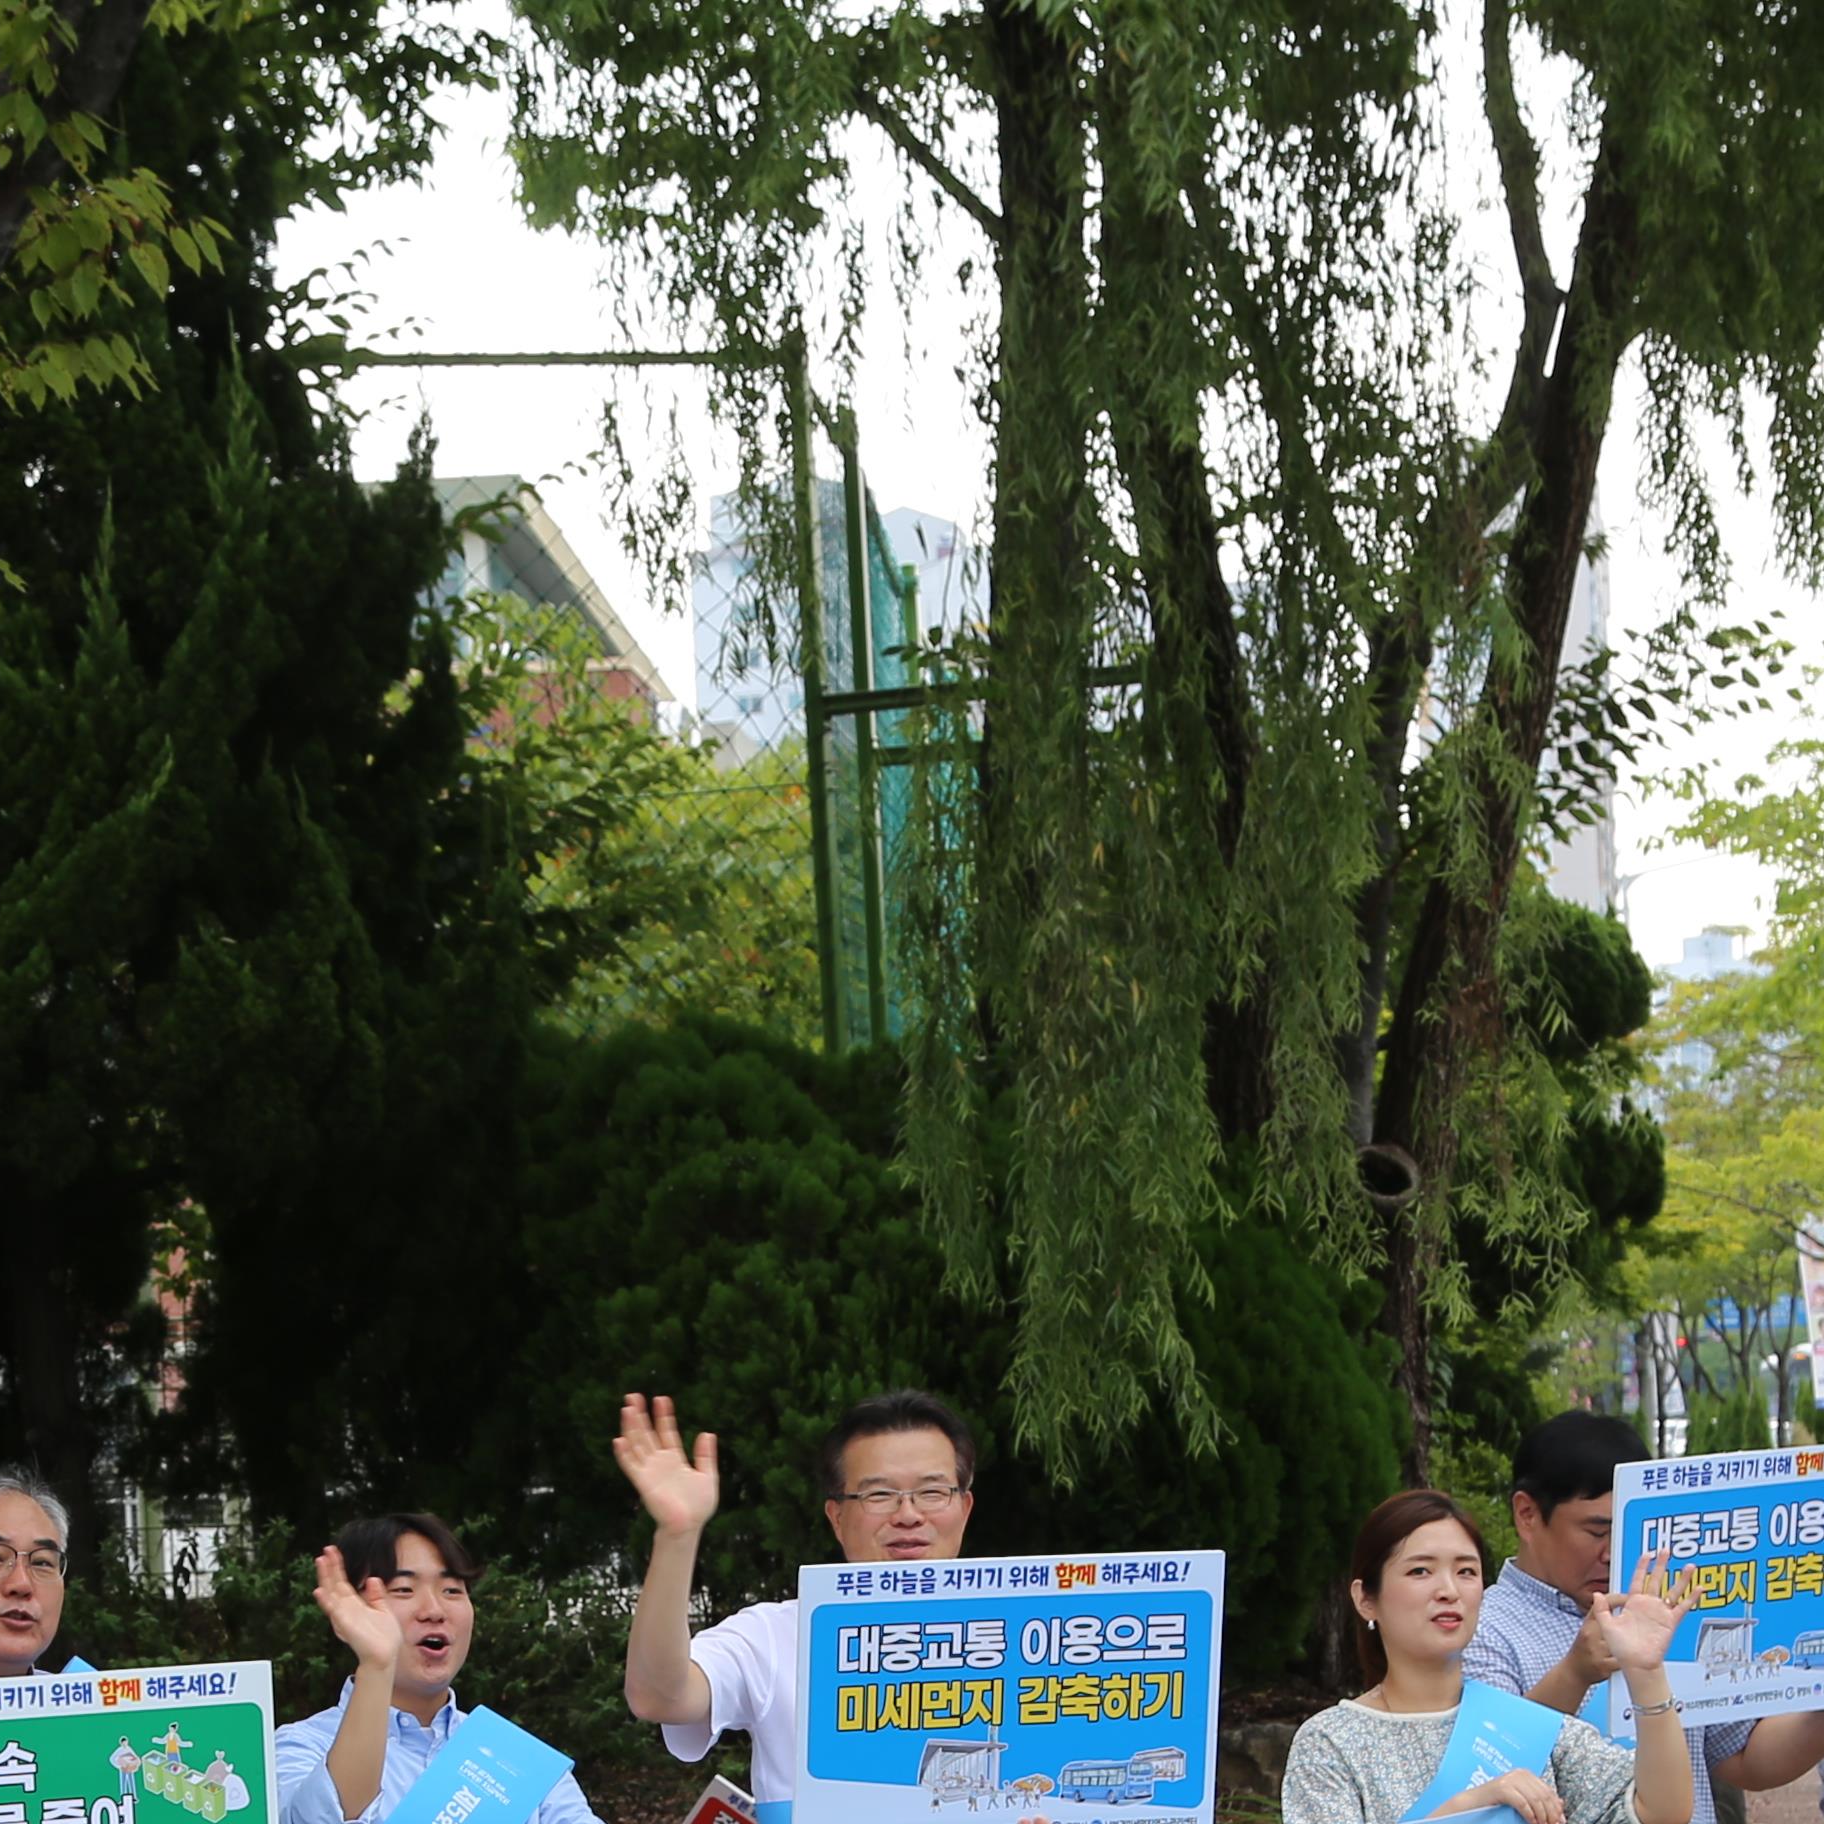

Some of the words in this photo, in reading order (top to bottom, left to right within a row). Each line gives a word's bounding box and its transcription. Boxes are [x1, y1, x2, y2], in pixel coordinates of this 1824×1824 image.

[1642, 1467, 1668, 1490] 푸른
[1673, 1462, 1713, 1487] 하늘을
[1717, 1460, 1759, 1481] 지키기
[1762, 1456, 1792, 1476] 위해
[1795, 1451, 1824, 1476] 함께
[1642, 1506, 1760, 1560] 대중교통
[836, 1570, 874, 1596] 푸른
[879, 1567, 937, 1594] 하늘을
[943, 1566, 1003, 1589] 지키기
[1009, 1565, 1049, 1588] 위해
[1055, 1562, 1096, 1586] 함께
[1102, 1560, 1191, 1586] 해주세요!
[836, 1619, 1007, 1674] 대중교통
[1021, 1613, 1187, 1666] 이용으로
[50, 1683, 93, 1707] 위해
[97, 1678, 142, 1706] 함께
[146, 1672, 237, 1700] 해주세요!
[836, 1676, 1005, 1733] 미세먼지
[1018, 1670, 1184, 1726] 감축하기
